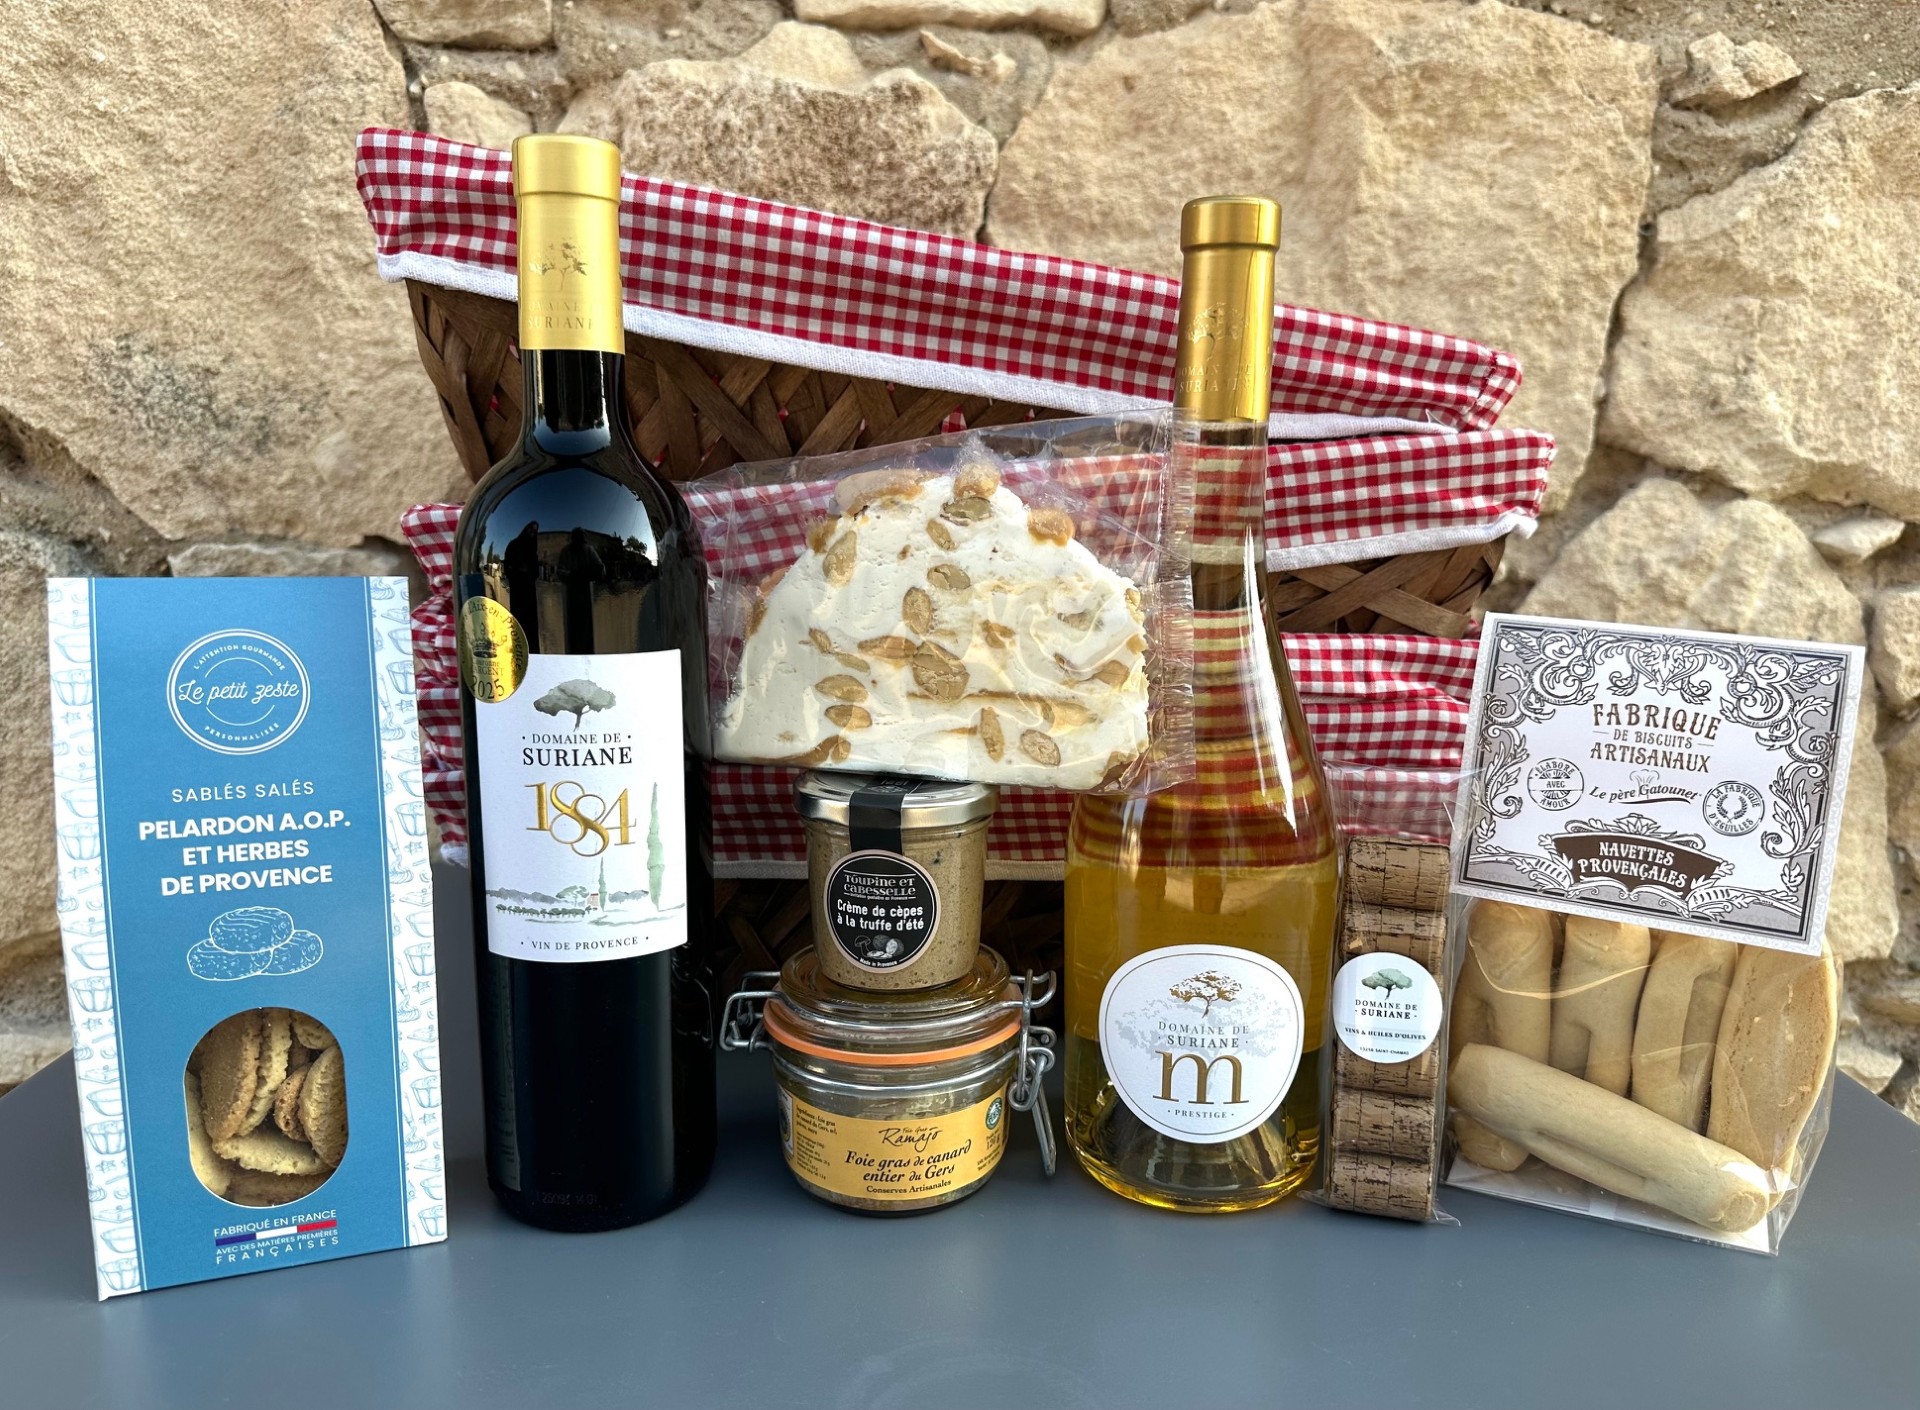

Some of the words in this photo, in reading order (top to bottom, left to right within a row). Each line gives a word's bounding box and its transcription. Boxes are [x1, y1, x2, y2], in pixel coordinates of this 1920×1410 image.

[193, 644, 239, 670] L'ATTENTION
[242, 644, 286, 671] GOURMANDE
[178, 679, 205, 705] Le
[206, 681, 249, 706] petit
[251, 680, 300, 705] zeste
[470, 675, 505, 700] 2025
[1592, 703, 1722, 741] FABRIQUE
[532, 733, 598, 744] DOMAINE
[603, 733, 622, 744] DE
[1613, 728, 1629, 742] DE
[1634, 731, 1693, 749] BISCUITS
[523, 746, 632, 767] SURIANE
[1590, 742, 1711, 773] ARTISANAUX
[172, 783, 247, 803] SABLÉS
[255, 779, 315, 798] SALÉS
[1546, 780, 1566, 788] AVEC
[1589, 786, 1607, 799] Le
[1608, 788, 1636, 803] père
[1638, 784, 1699, 800] Gatounet
[1711, 787, 1724, 800] LA
[1724, 784, 1761, 808] FABRIQUE
[1539, 797, 1571, 809] AMOUR
[139, 813, 274, 841] PELARDON
[279, 810, 352, 832] A.O.P.
[524, 780, 637, 857] 1884
[182, 846, 212, 866] ET
[217, 839, 310, 864] HERBES
[1599, 841, 1675, 866] NAVETTES
[161, 876, 194, 897] DE
[199, 865, 333, 893] PROVENCE
[1577, 857, 1688, 888] PROVENÇALES
[837, 898, 868, 916] Crème
[872, 904, 886, 917] de
[889, 905, 924, 919] cèpes
[837, 911, 843, 925] à
[845, 914, 856, 927] la
[859, 917, 892, 931] truffe
[896, 917, 925, 931] d'été
[532, 940, 551, 950] VIN
[555, 941, 571, 950] DE
[575, 936, 639, 950] PROVENCE
[1355, 999, 1401, 1010] DOMAINE
[1404, 1003, 1418, 1011] DE
[1361, 1008, 1411, 1020] SURIANE
[1158, 1021, 1225, 1035] DOMAINE
[1232, 1025, 1249, 1035] DE
[1345, 1027, 1360, 1035] VINS
[1368, 1030, 1393, 1038] HUILES
[1394, 1032, 1427, 1041] D'OLIVES
[1167, 1035, 1239, 1049] SURIANE
[1153, 1050, 1250, 1105] m
[1174, 1109, 1228, 1119] PRESTIGE
[845, 1150, 875, 1167] Foie
[877, 1158, 911, 1172] gras
[913, 1156, 926, 1166] de
[926, 1138, 972, 1165] canard
[863, 1169, 906, 1183] entier
[909, 1170, 922, 1181] du
[924, 1164, 955, 1180] Gers
[866, 1185, 907, 1194] Conserves
[908, 1180, 952, 1193] Artisanales
[213, 1218, 271, 1238] FABRIQUÉ
[273, 1218, 289, 1227] EN
[291, 1209, 337, 1225] FRANCE
[215, 1236, 340, 1265] FRANÇAISES
[216, 1245, 239, 1255] AVEC
[240, 1242, 256, 1252] DES
[257, 1234, 296, 1249] MATIÈRES
[297, 1228, 339, 1242] PREMIÈRES
